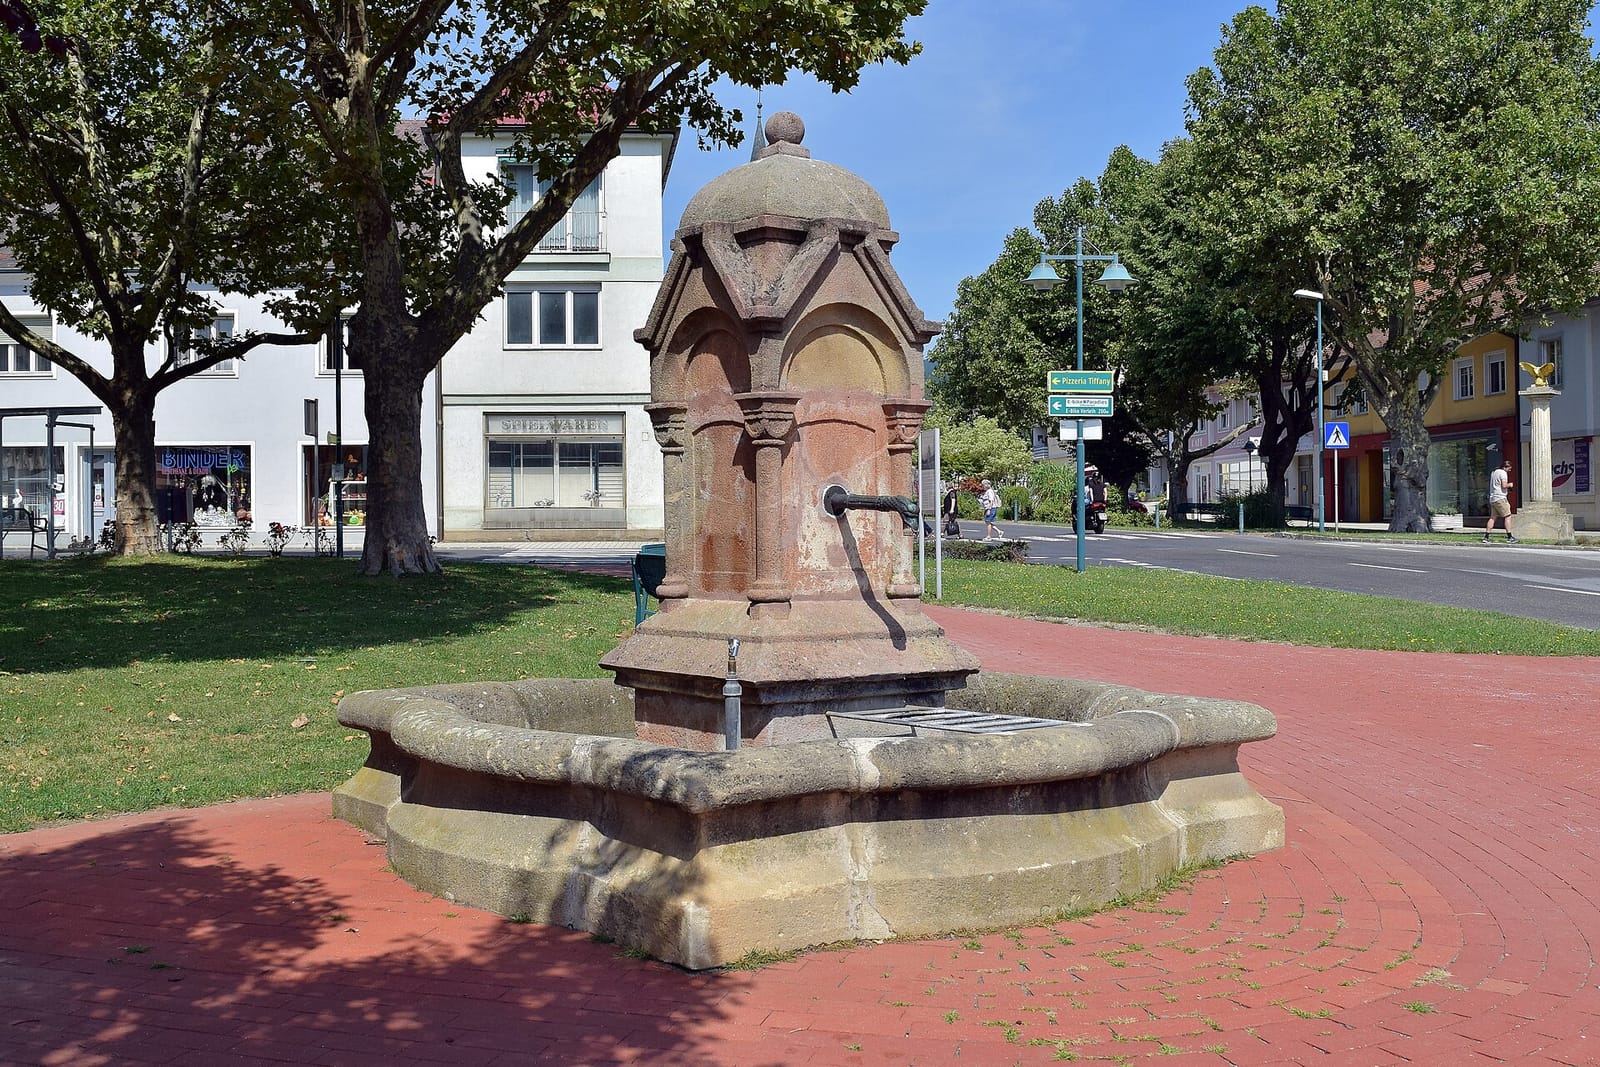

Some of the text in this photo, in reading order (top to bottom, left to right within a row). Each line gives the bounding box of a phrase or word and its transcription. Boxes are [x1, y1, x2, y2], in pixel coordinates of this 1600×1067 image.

[1062, 377, 1110, 386] Pizzeria Tiffany
[501, 418, 609, 432] SPIELWAREN
[161, 450, 245, 469] BINDER
